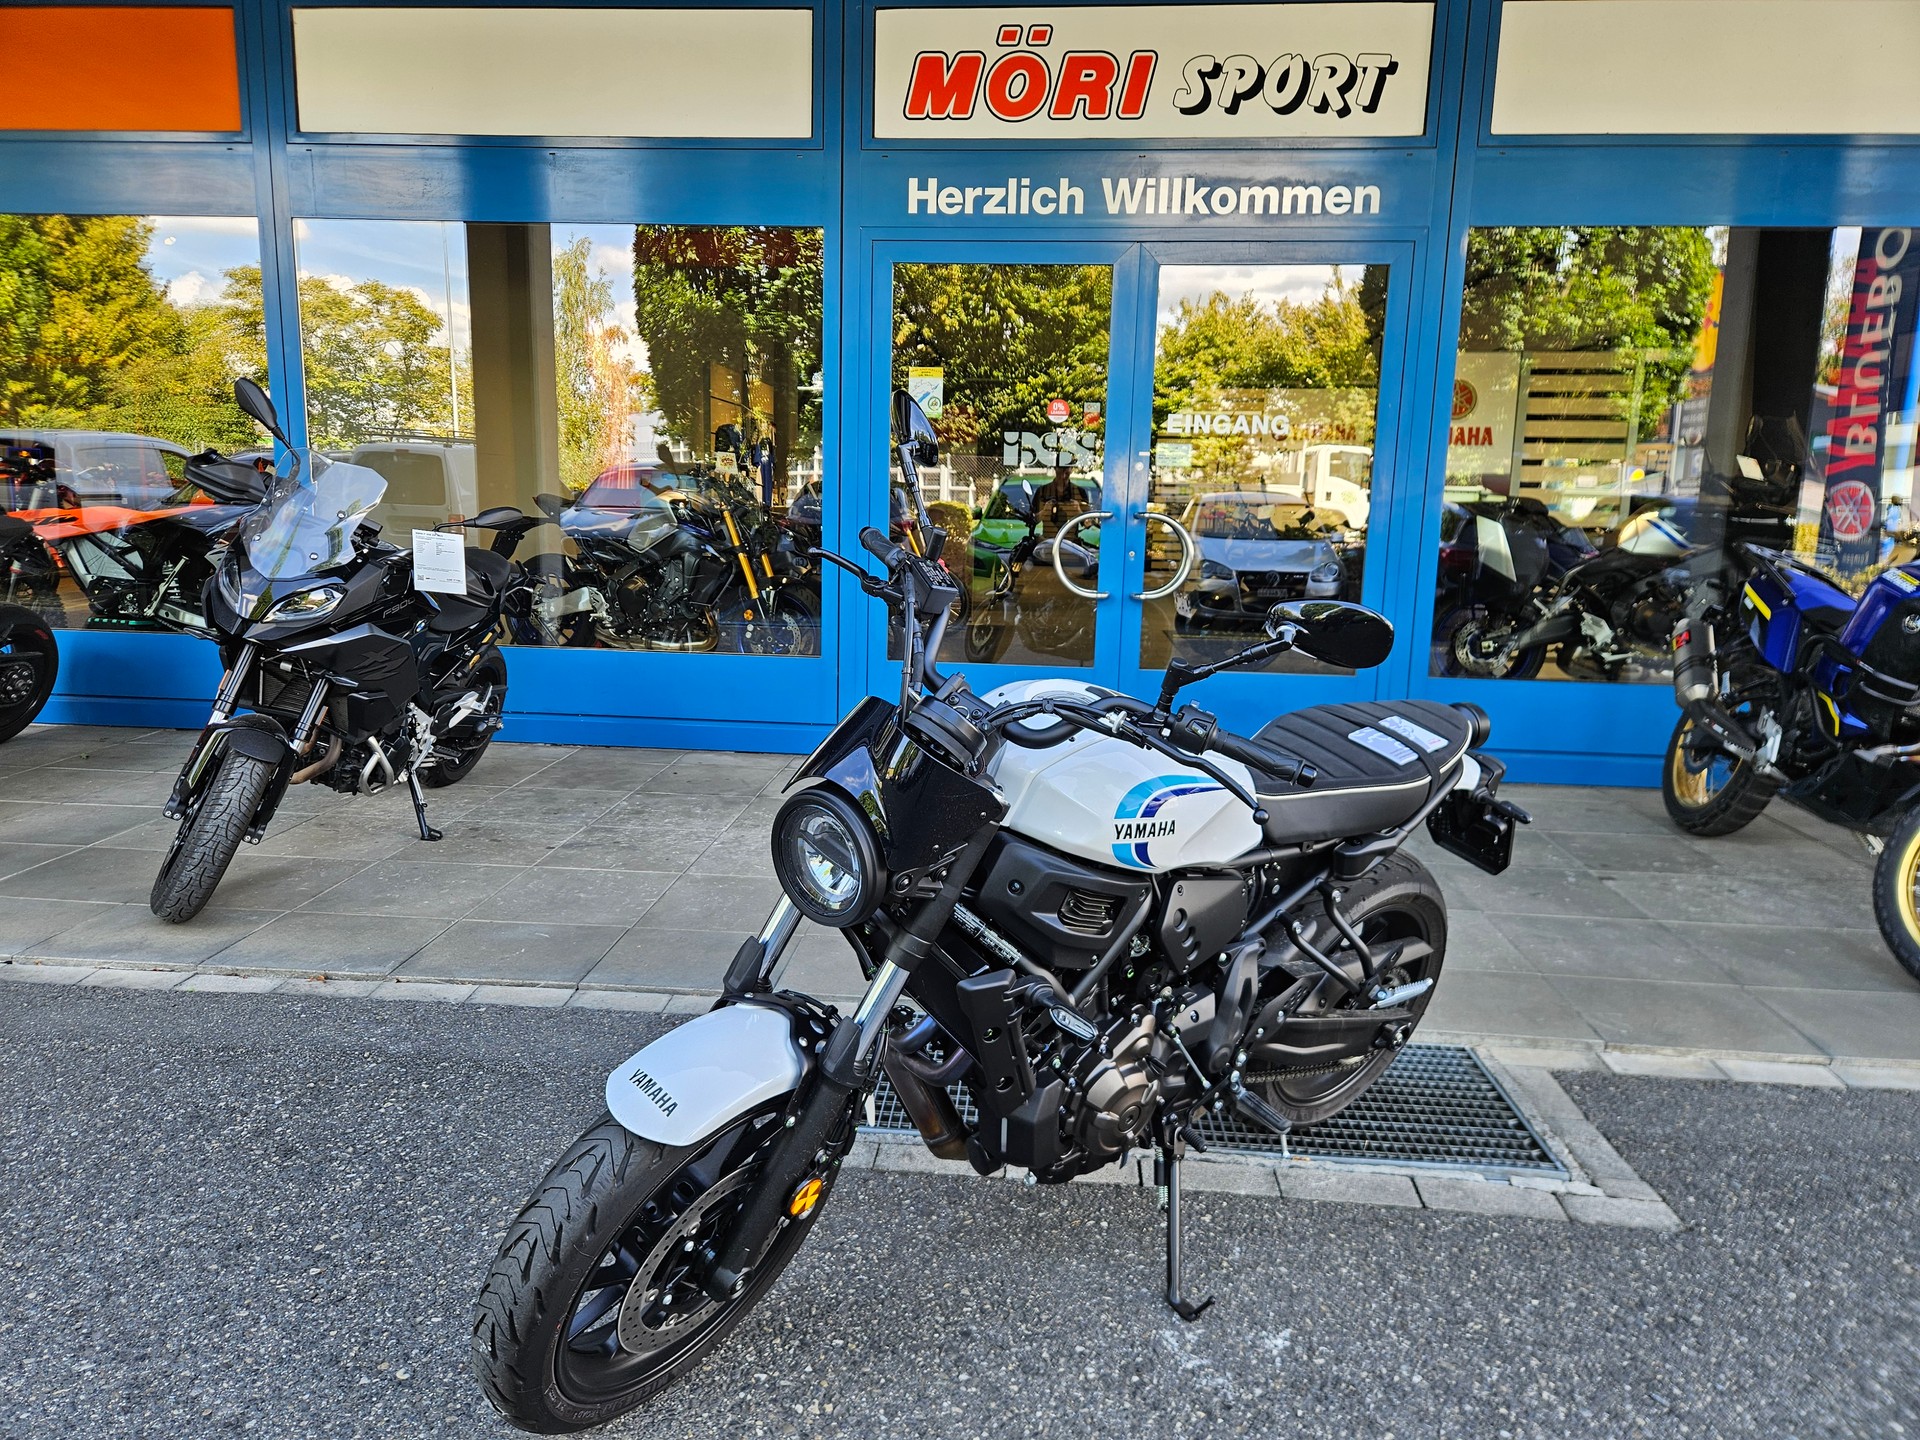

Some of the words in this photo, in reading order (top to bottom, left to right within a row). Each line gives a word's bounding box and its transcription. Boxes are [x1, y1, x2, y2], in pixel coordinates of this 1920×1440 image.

[904, 24, 1158, 122] MÖRI
[1173, 53, 1398, 119] SPORT
[907, 177, 1084, 215] Herzlich
[1102, 178, 1381, 215] Willkommen
[1052, 402, 1065, 411] 0%
[1167, 413, 1290, 435] EINGANG
[1114, 819, 1176, 840] YAMAHA
[629, 1068, 679, 1118] YAMAHA
